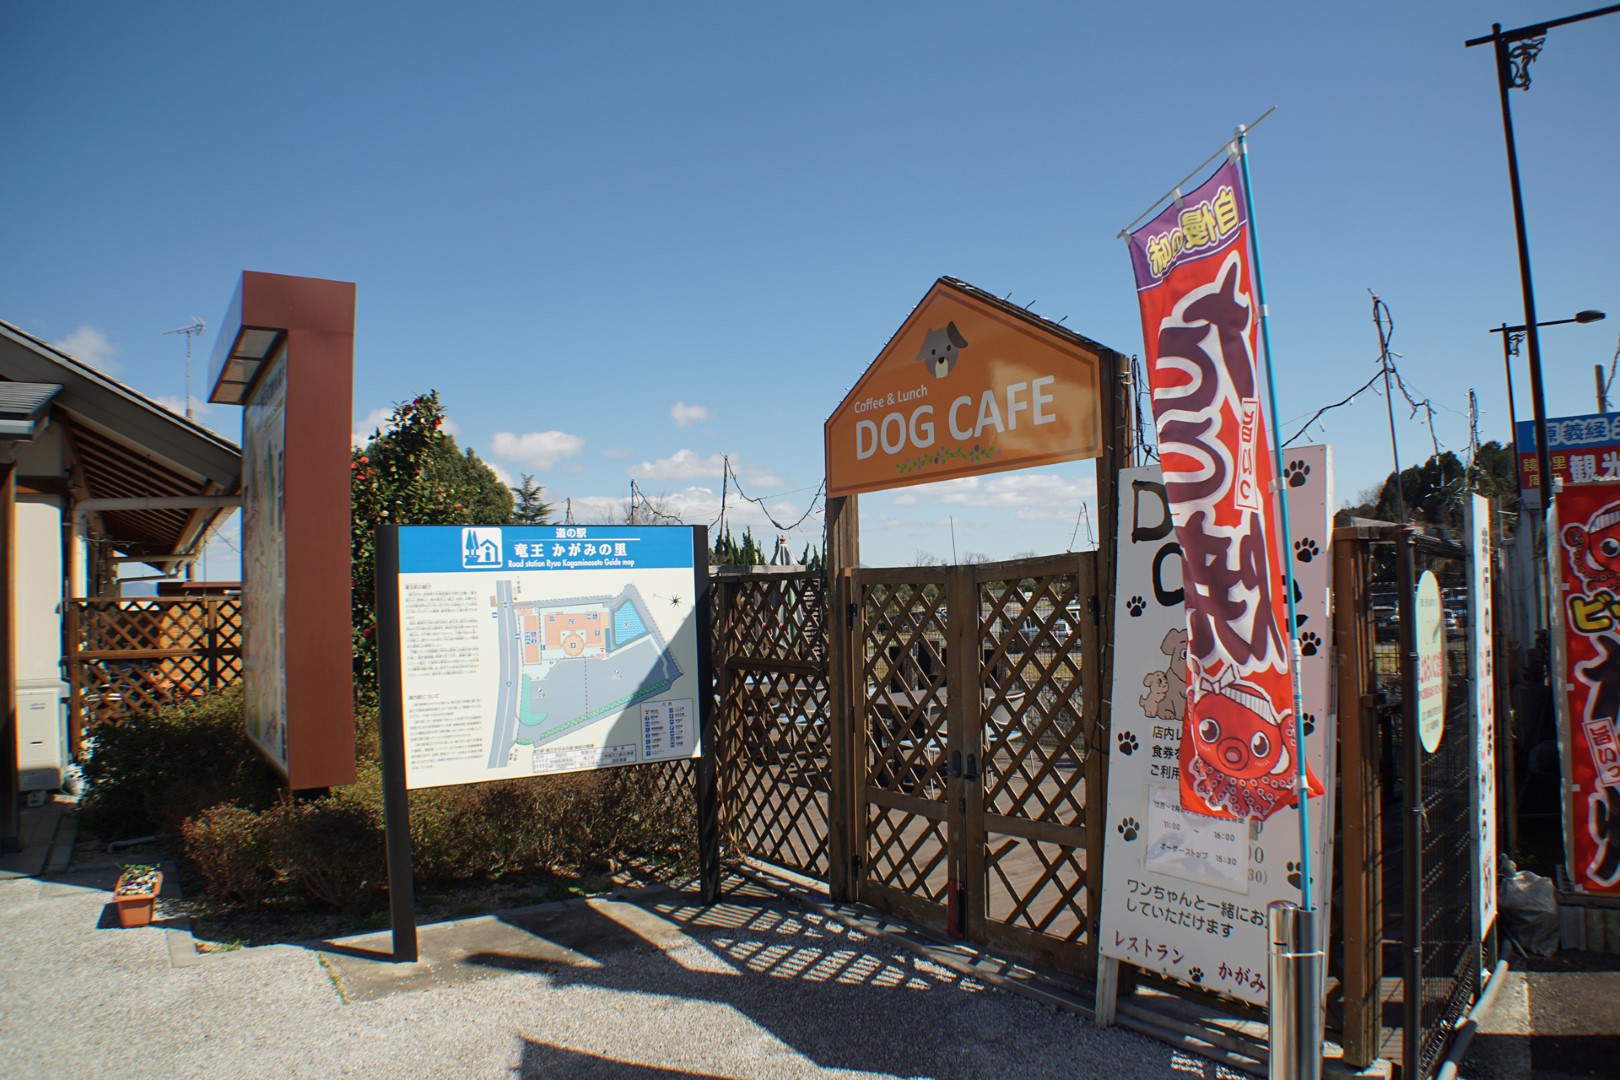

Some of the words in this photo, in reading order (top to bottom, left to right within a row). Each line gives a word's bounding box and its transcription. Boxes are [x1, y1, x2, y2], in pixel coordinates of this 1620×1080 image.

[854, 399, 884, 414] Coffee
[887, 393, 895, 405] &
[898, 384, 928, 403] Lunch
[855, 405, 935, 460] DOG
[948, 375, 1056, 441] CAFE
[555, 528, 587, 539] 道の駅
[508, 559, 524, 568] Road
[525, 559, 546, 567] station
[604, 557, 621, 566] Guide
[622, 559, 635, 568] map
[514, 543, 544, 558] 竜王
[552, 543, 627, 557] かがみの里
[1163, 821, 1181, 831] 11:00
[1214, 831, 1235, 842] 16:00
[1215, 854, 1237, 866] 15:30
[1127, 879, 1268, 929] ワンちゃんと一緒にお
[1126, 898, 1234, 938] していただけます
[1114, 930, 1185, 965] レストラン
[1217, 961, 1266, 993] かがみ
